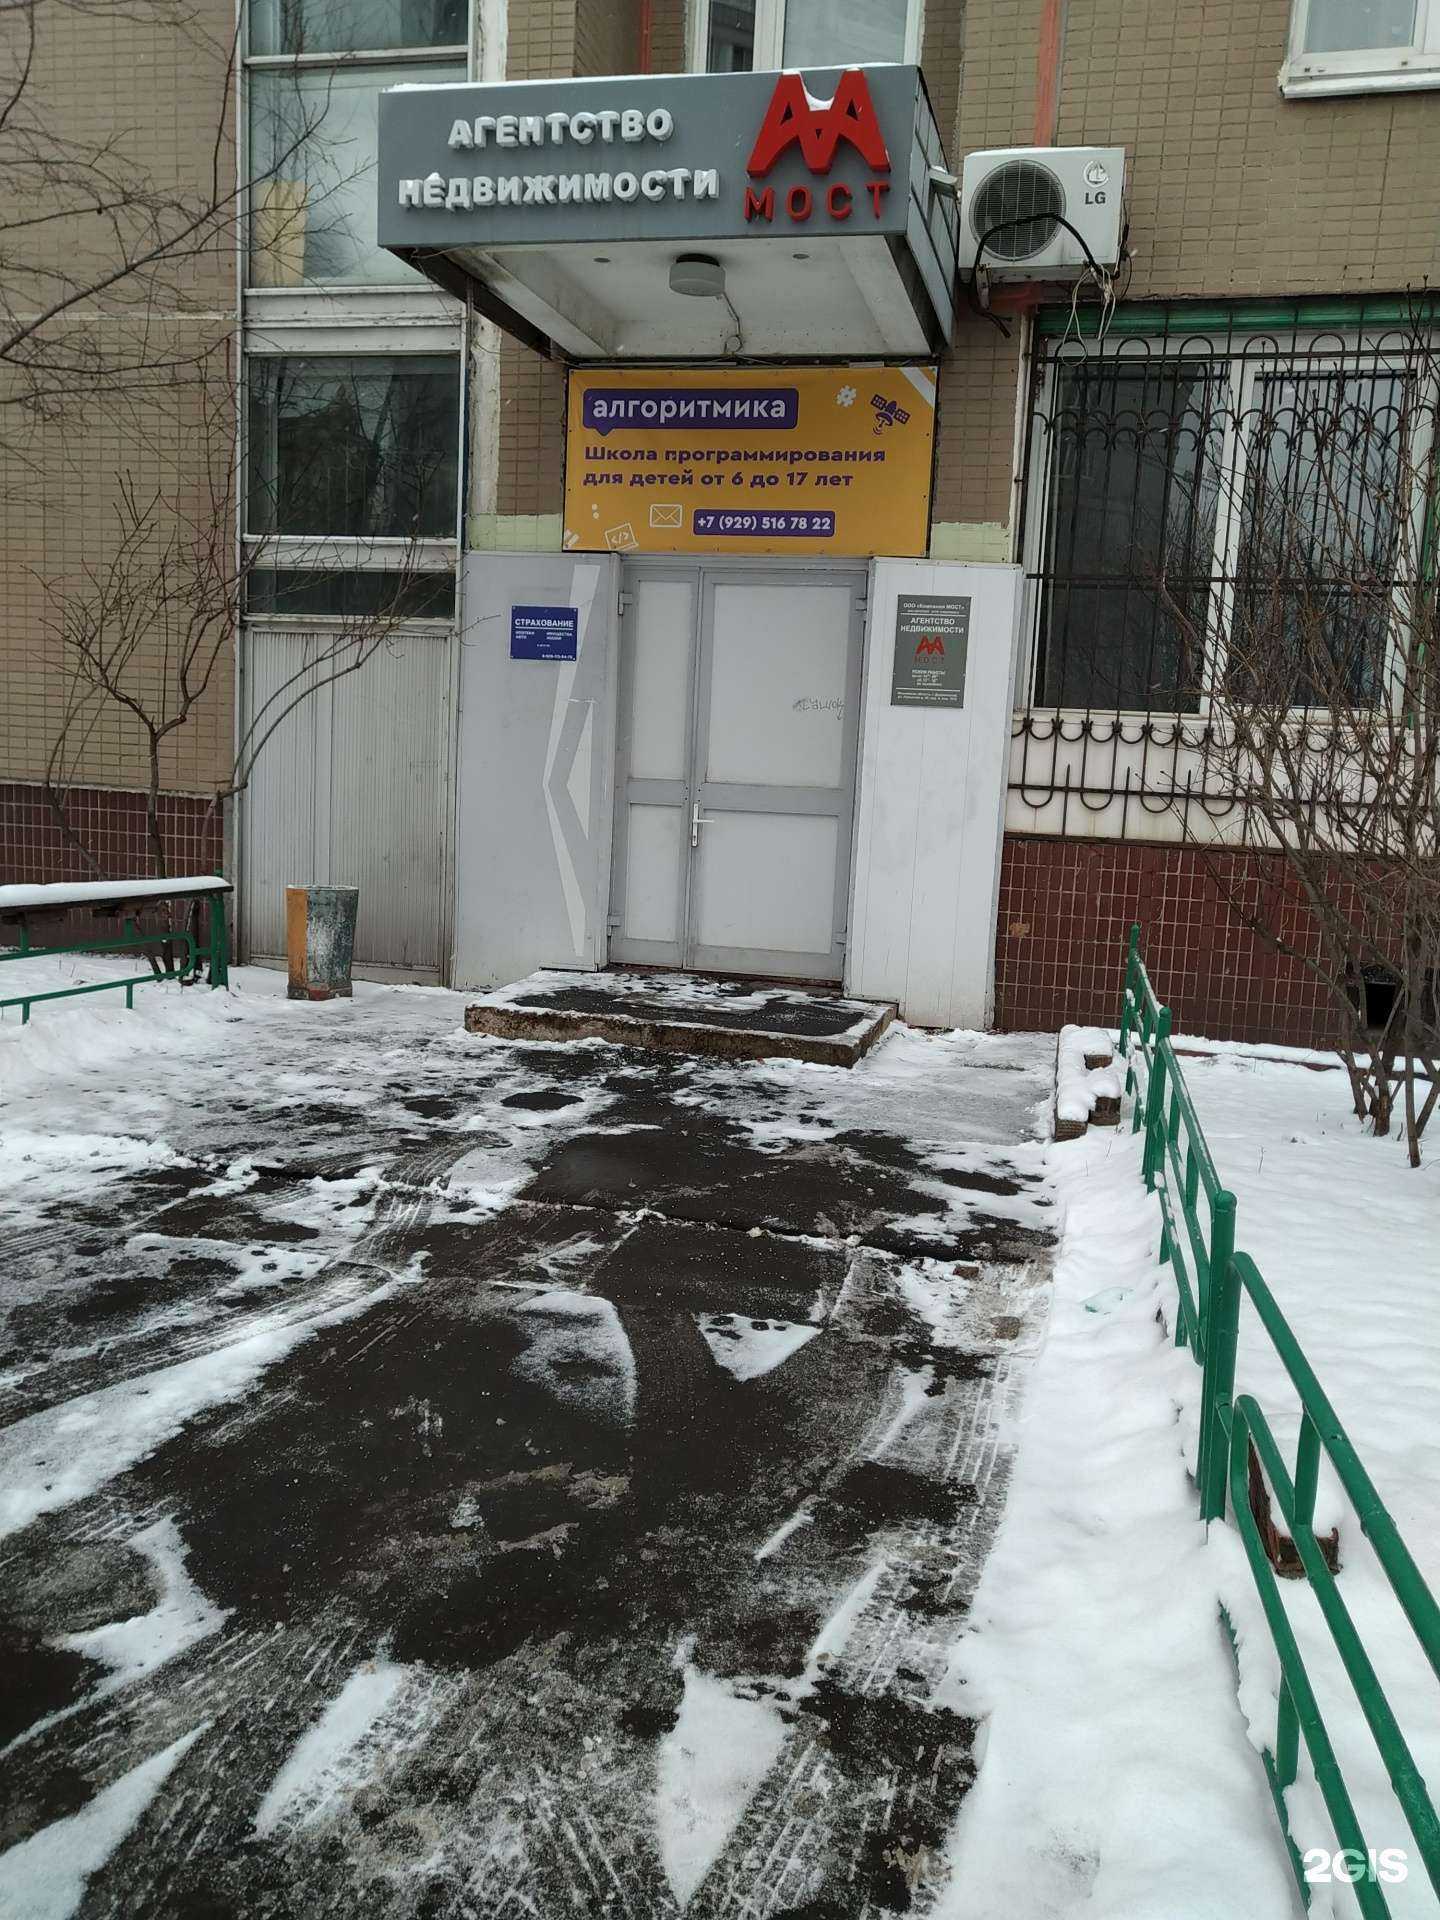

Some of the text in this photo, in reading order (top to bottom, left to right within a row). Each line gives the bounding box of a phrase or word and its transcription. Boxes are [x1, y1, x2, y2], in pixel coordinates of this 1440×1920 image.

[448, 107, 673, 149] АГЕНТСТВО
[398, 167, 721, 211] НЕДВИЖИМОСТИ
[1084, 191, 1106, 205] LG
[744, 181, 890, 222] МОСТ
[593, 399, 786, 423] алгоритмика
[585, 446, 886, 464] Школа программирования
[583, 469, 854, 488] для детей от 6 до 17 лет
[697, 514, 832, 531] +7 (929) 516 78 22
[515, 618, 574, 627] СТРАХОВАНИЕ
[900, 625, 964, 633] НЕДВИЖИМОСТИ
[910, 617, 955, 625] АГЕНТСТВО
